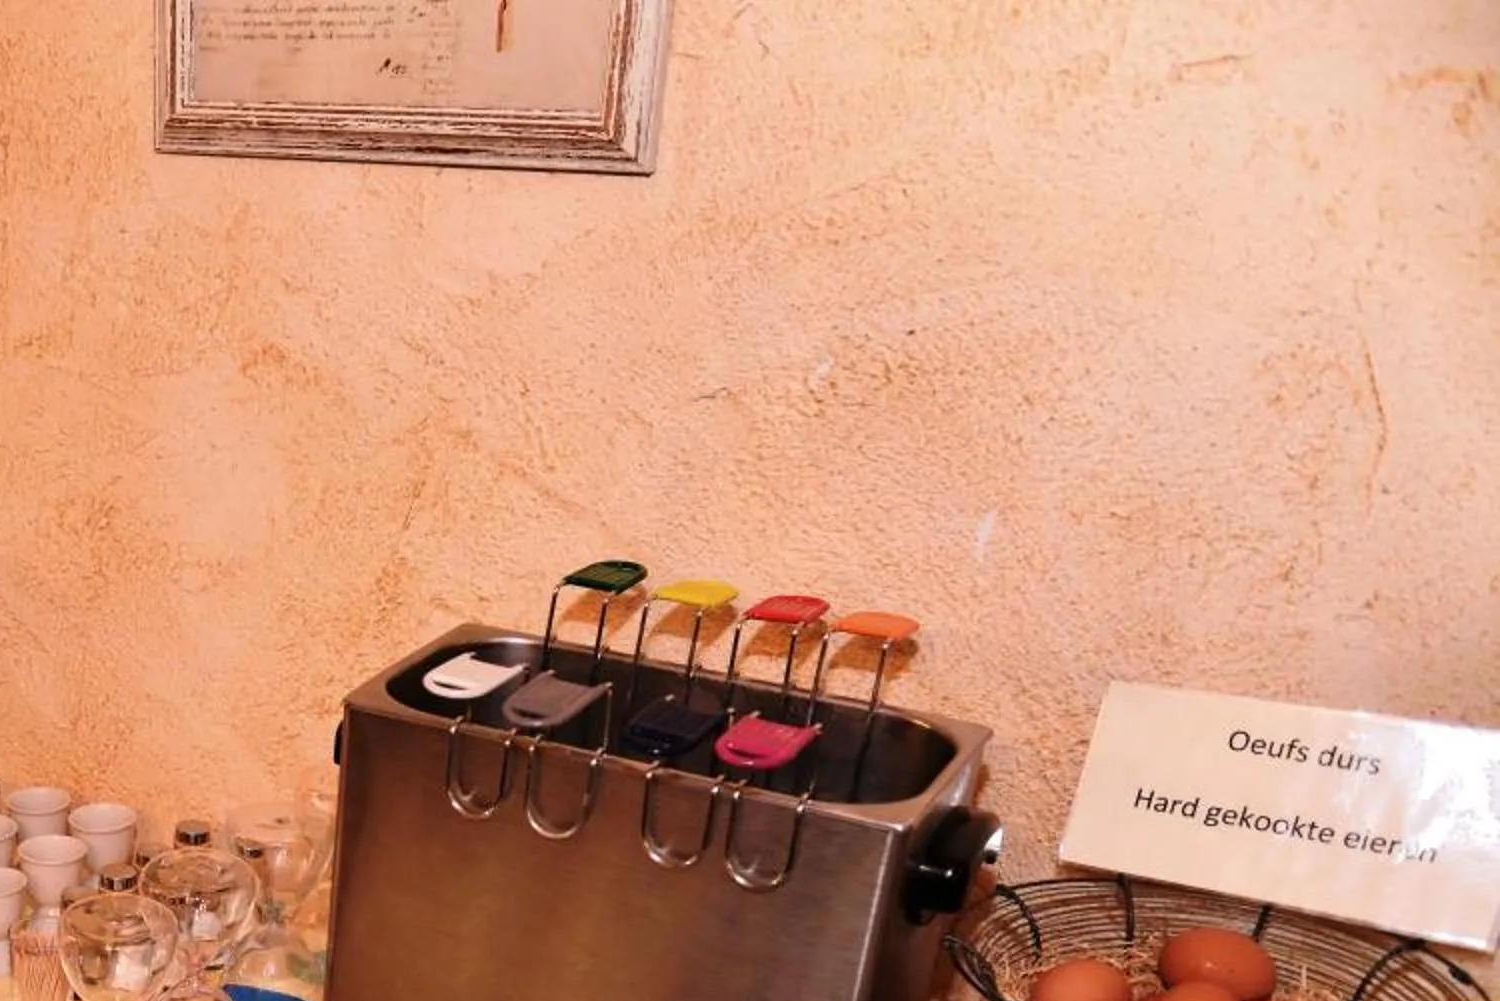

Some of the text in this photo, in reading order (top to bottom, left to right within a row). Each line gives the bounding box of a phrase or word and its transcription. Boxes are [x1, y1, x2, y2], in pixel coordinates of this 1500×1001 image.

[1228, 730, 1381, 775] Oeufs durs
[1133, 788, 1200, 819] Hard
[1203, 803, 1336, 845] gekookte
